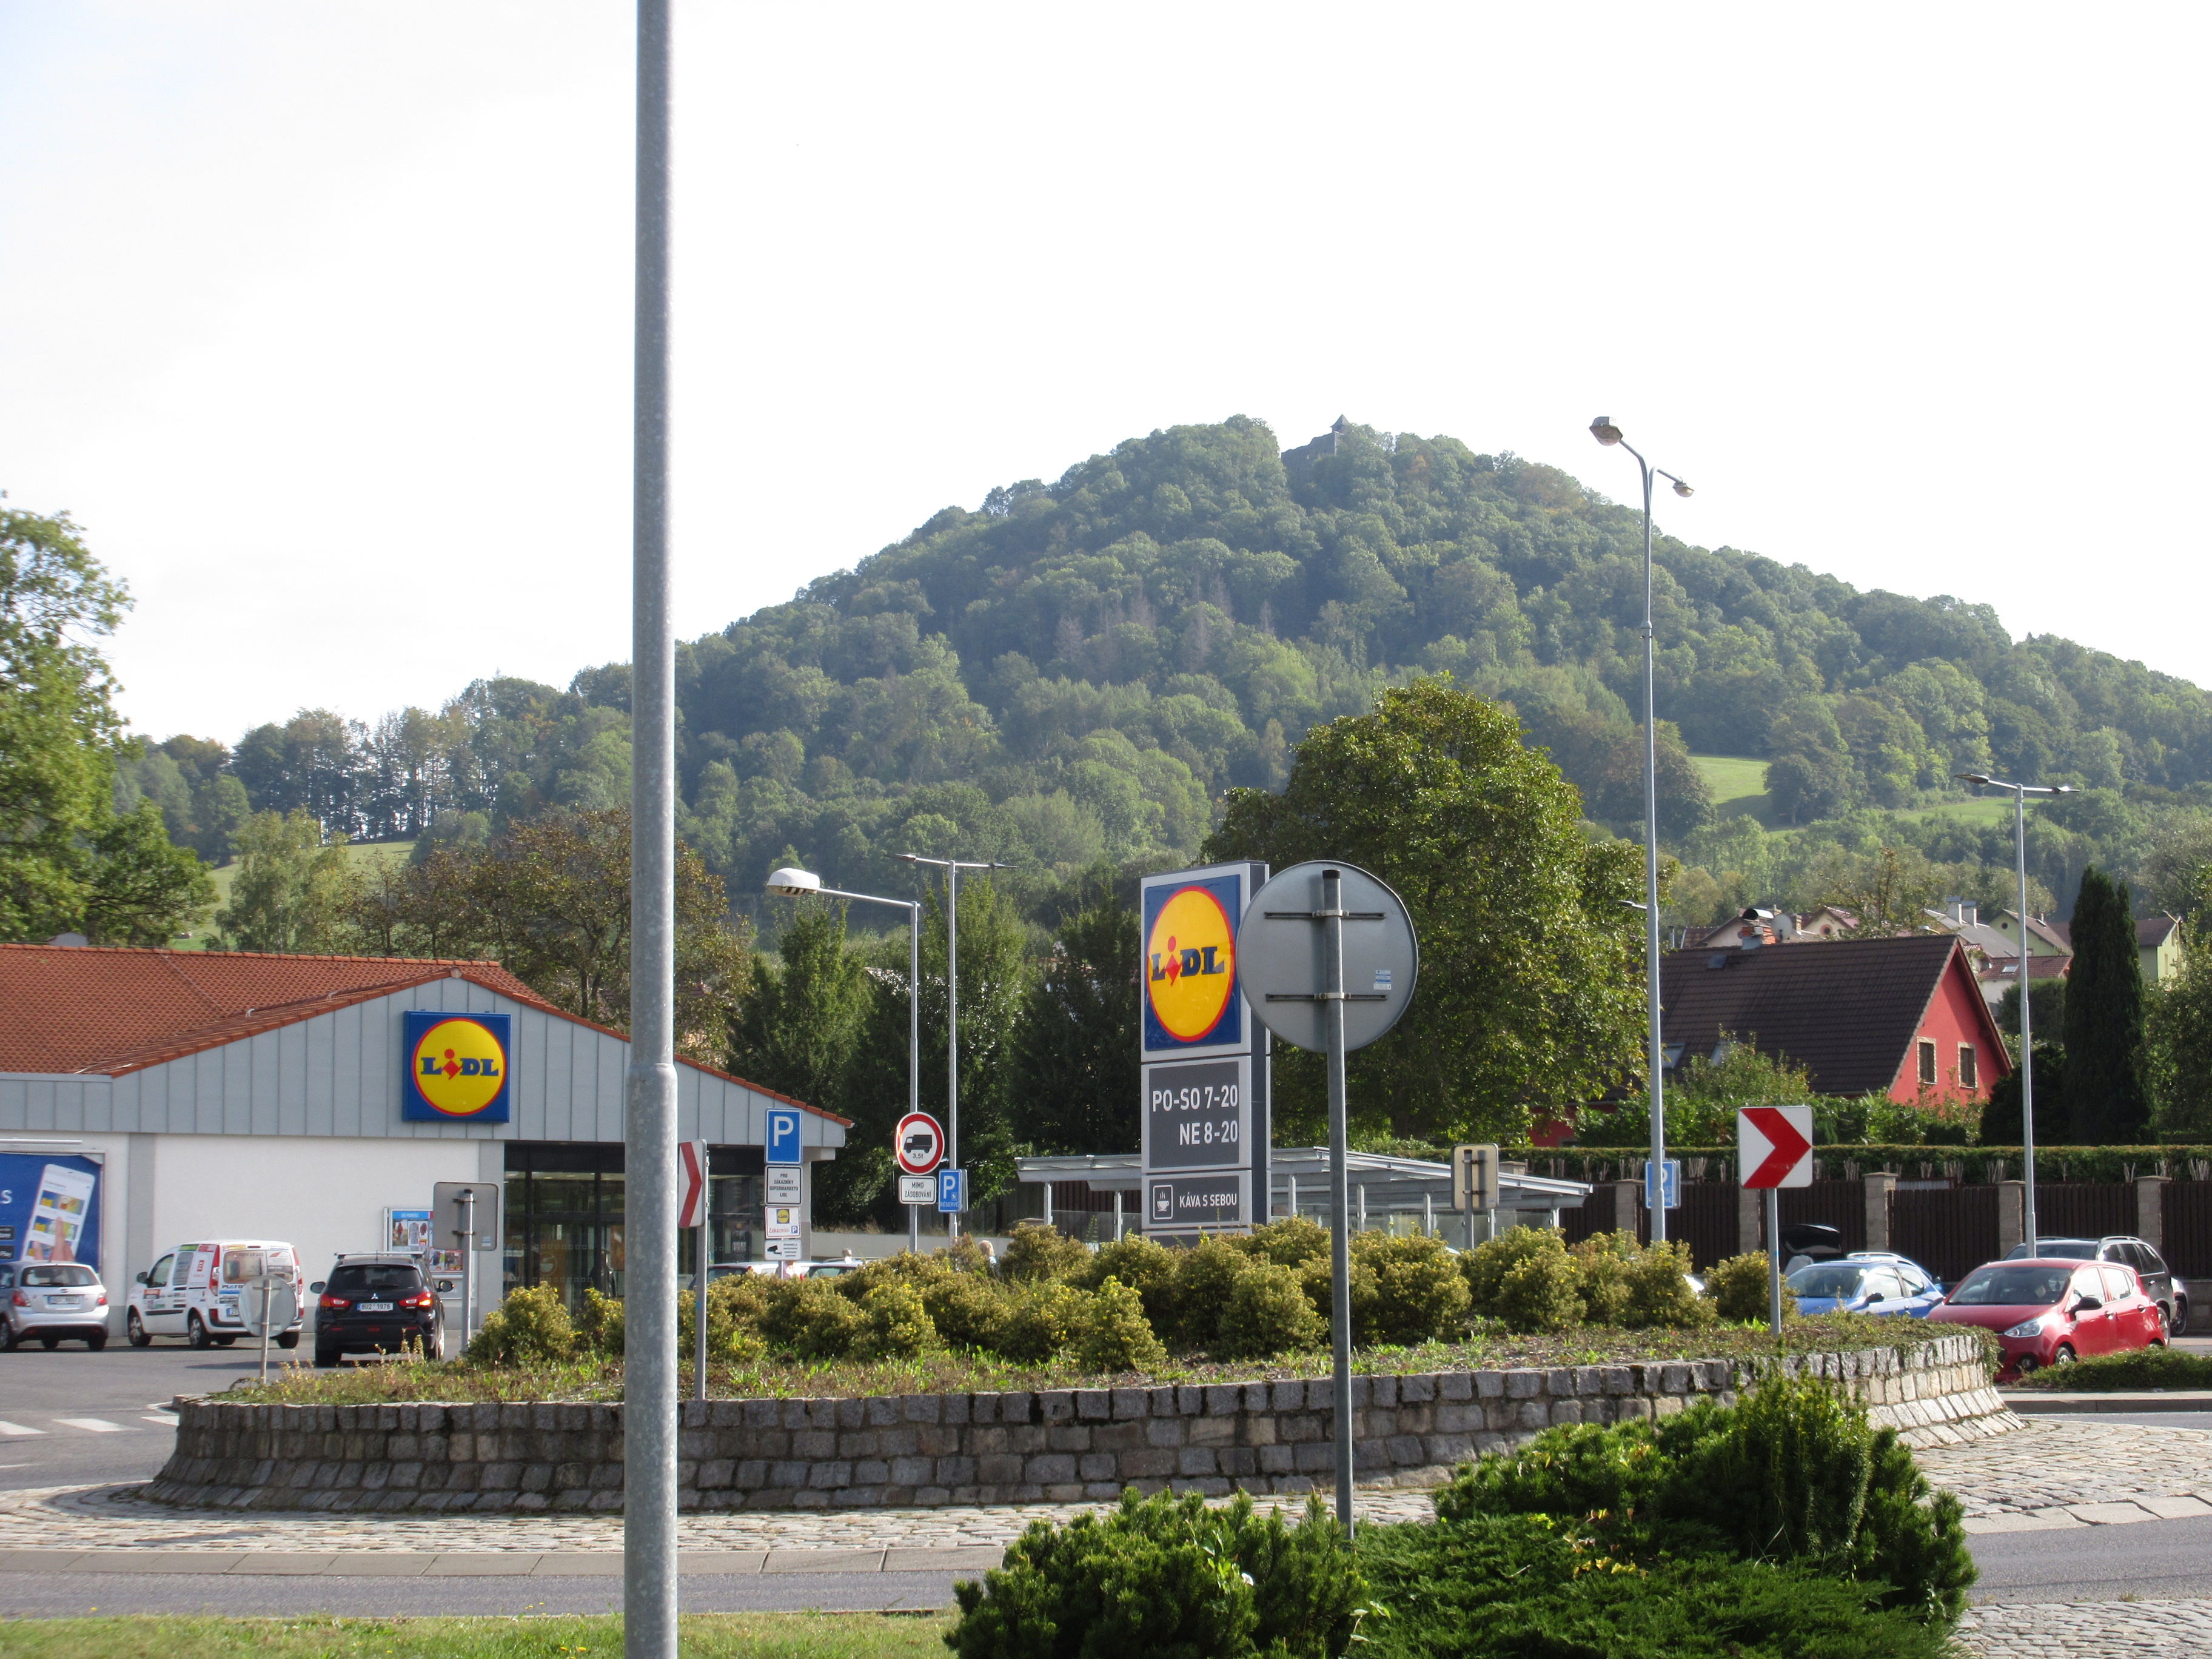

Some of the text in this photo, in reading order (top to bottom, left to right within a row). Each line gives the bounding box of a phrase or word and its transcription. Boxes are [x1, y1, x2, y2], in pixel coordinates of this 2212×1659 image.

[1152, 1085, 1238, 1112] PO-SO 7-20
[774, 1116, 794, 1147] P
[1179, 1121, 1238, 1145] NE 8-20
[943, 1175, 956, 1199] P
[1179, 1191, 1237, 1208] KÁVA S SEBOU
